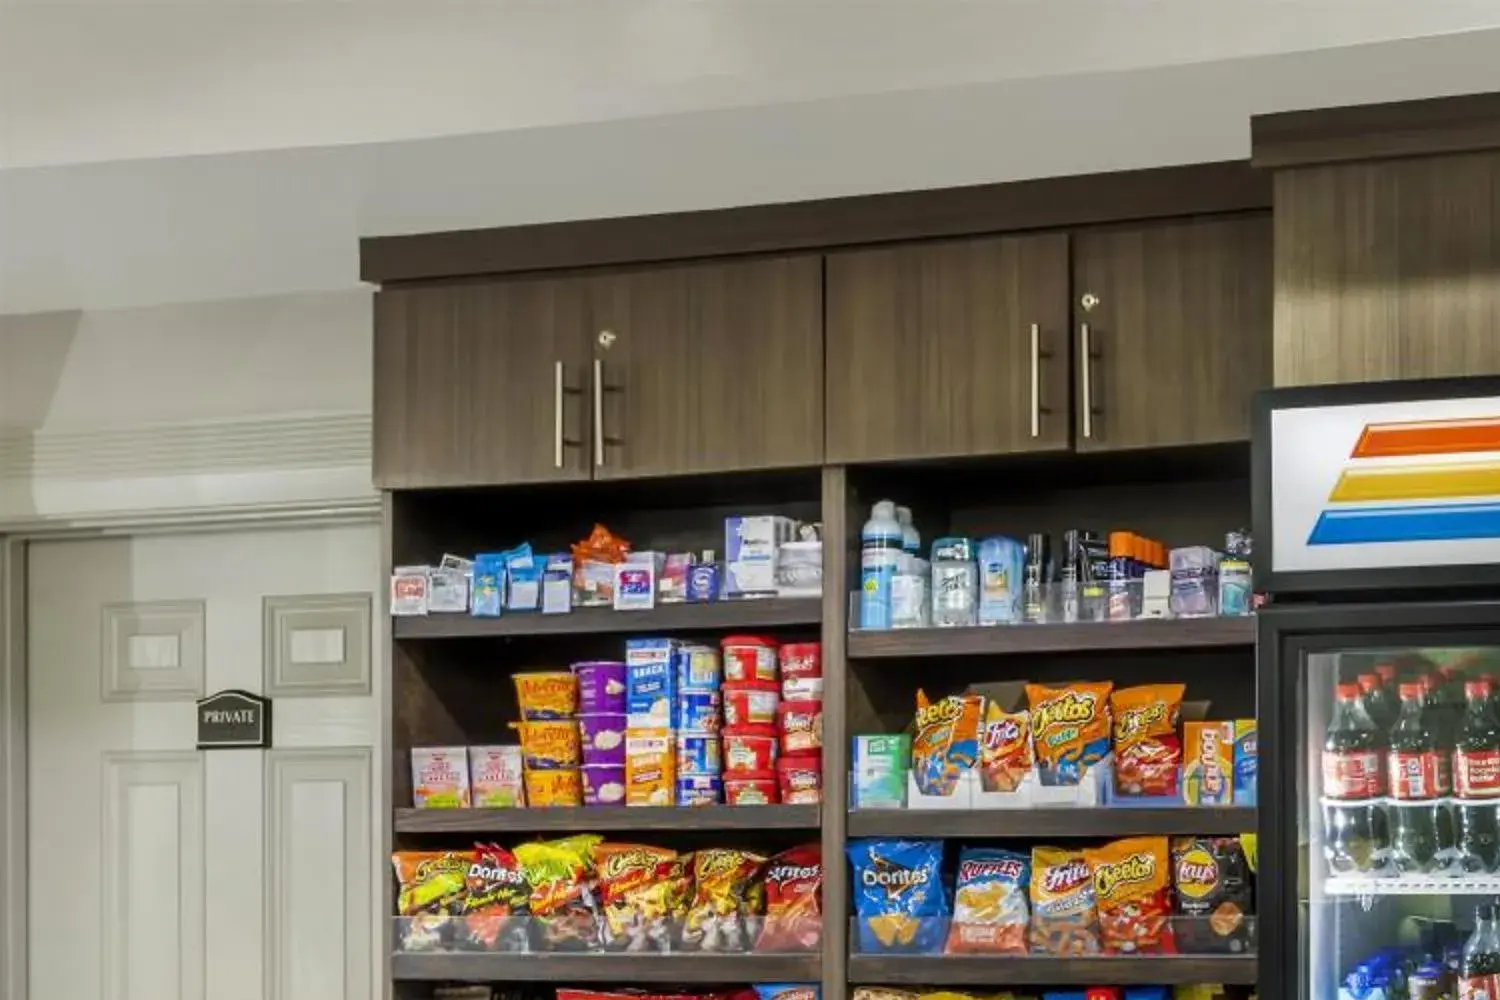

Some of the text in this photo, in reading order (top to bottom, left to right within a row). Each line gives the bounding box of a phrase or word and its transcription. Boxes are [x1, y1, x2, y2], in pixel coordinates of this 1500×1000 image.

[203, 709, 255, 723] PRIVATE
[468, 863, 524, 883] Doritos
[862, 869, 928, 885] Doritos
[1093, 855, 1156, 896] Cheetos
